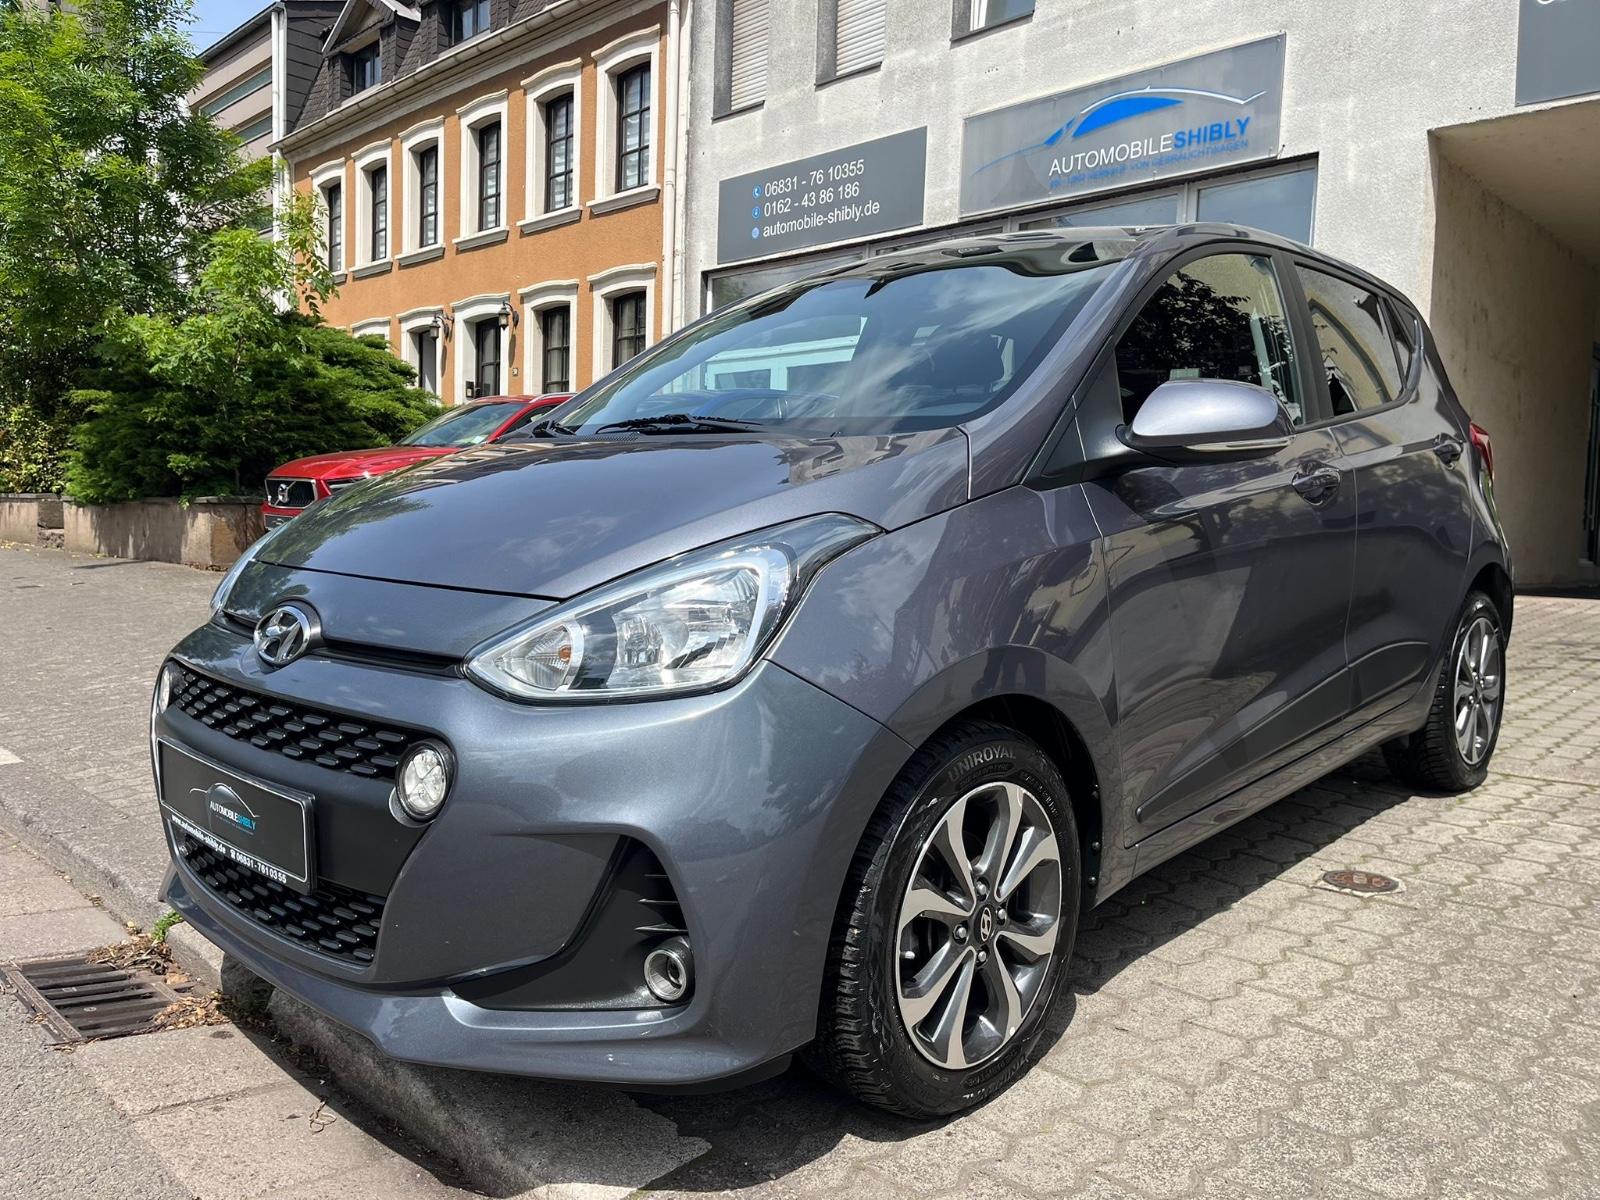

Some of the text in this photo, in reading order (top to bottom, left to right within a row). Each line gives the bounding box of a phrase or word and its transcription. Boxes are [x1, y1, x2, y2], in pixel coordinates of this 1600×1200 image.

[764, 176, 798, 198] 06831
[809, 169, 824, 188] 76
[828, 159, 865, 182] 10355
[764, 198, 791, 217] 0162
[801, 191, 815, 208] 43
[819, 187, 834, 205] 86
[837, 182, 860, 201] 186
[763, 200, 880, 238] automobile-shibly.de
[948, 745, 1017, 781] UNIROYAL
